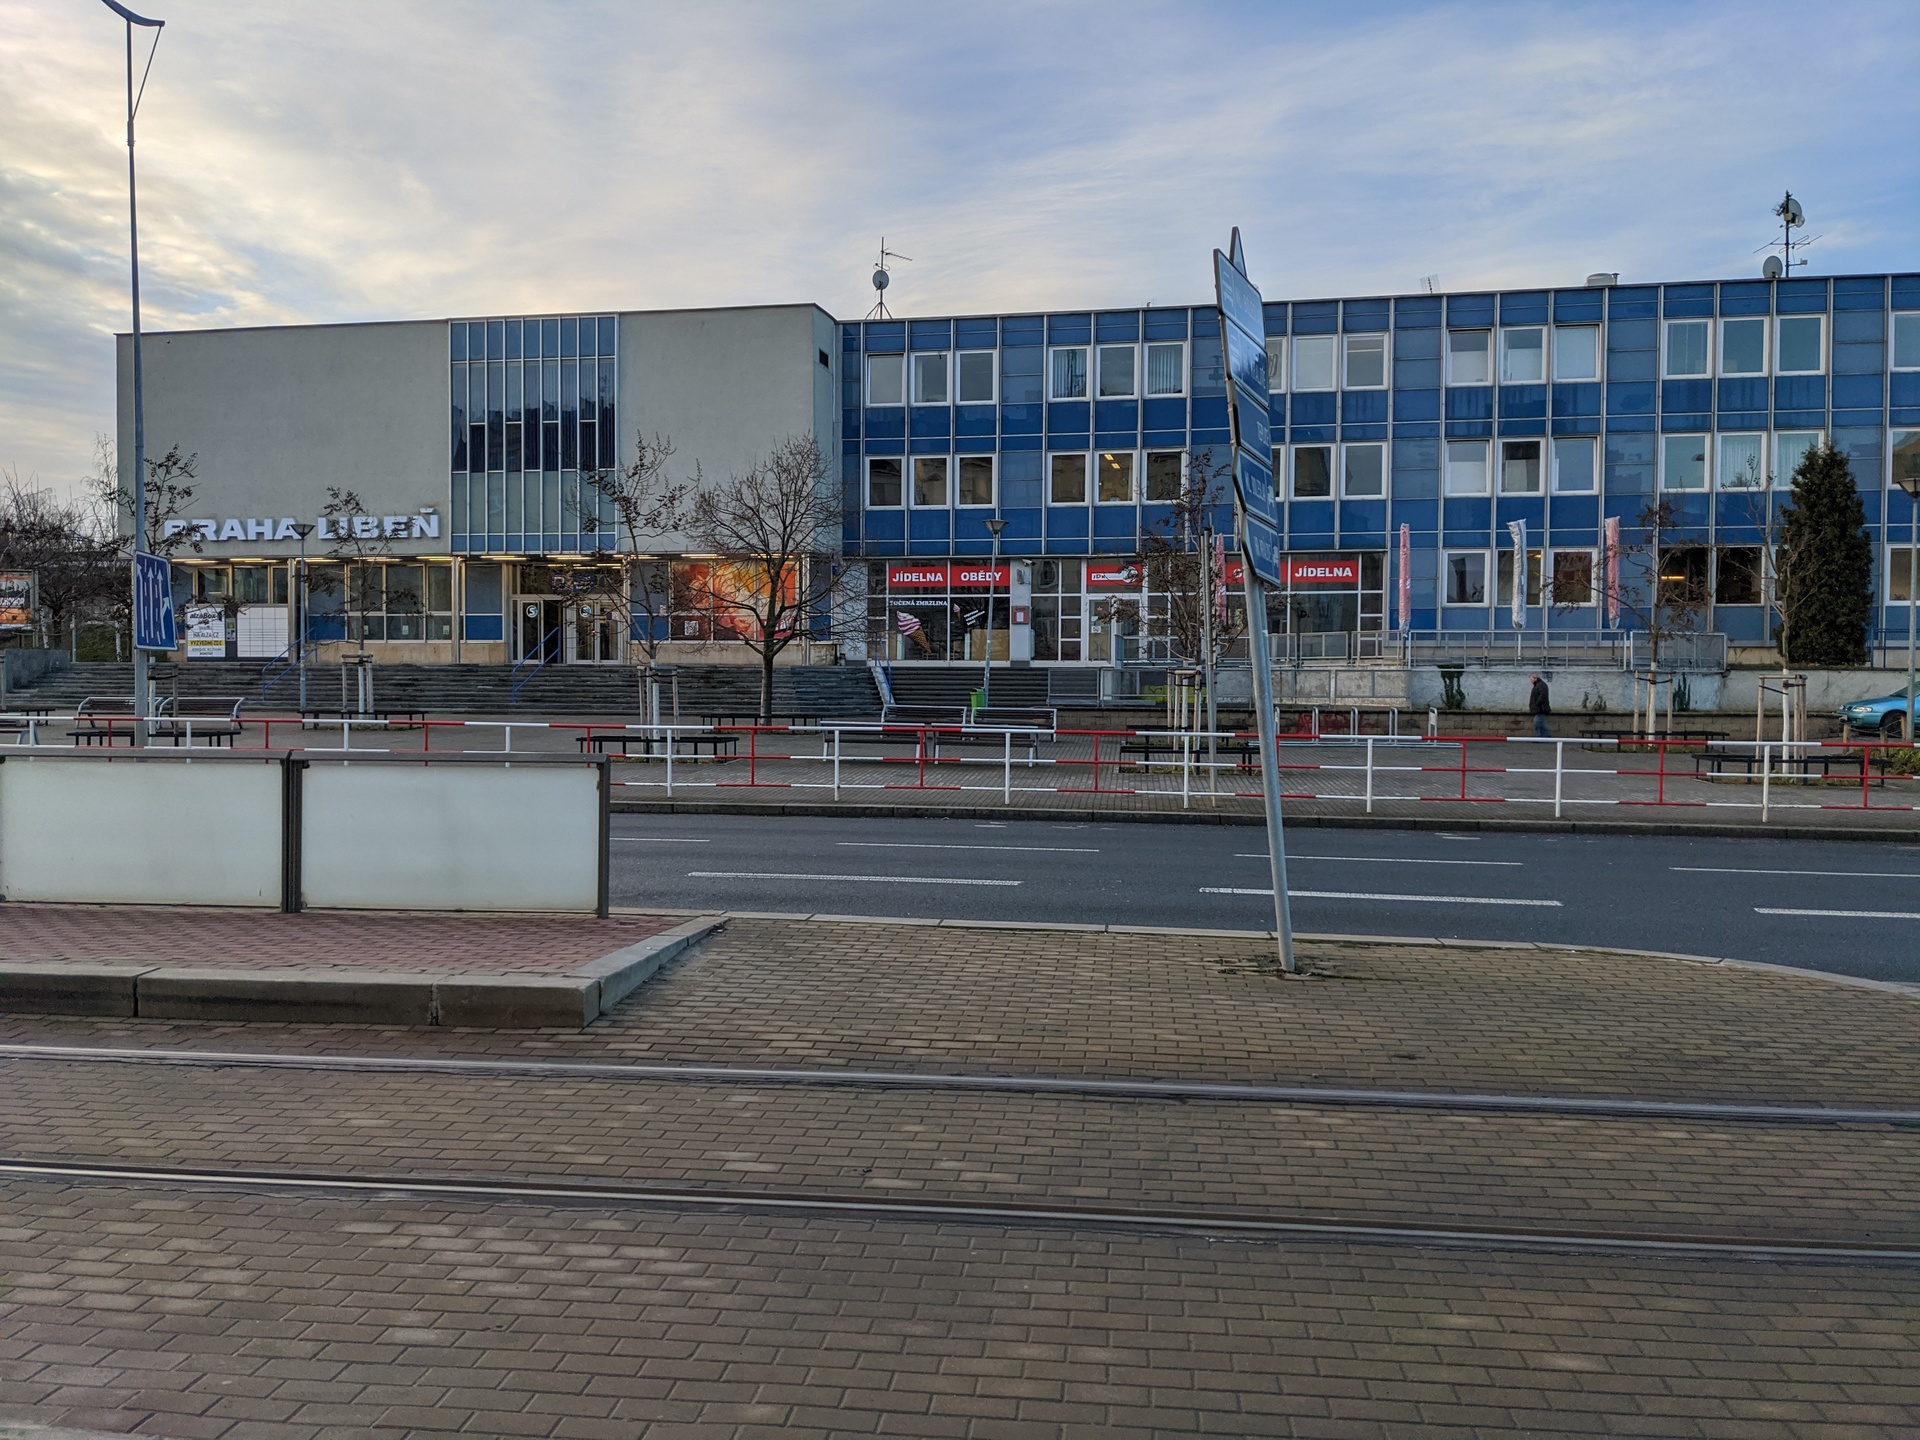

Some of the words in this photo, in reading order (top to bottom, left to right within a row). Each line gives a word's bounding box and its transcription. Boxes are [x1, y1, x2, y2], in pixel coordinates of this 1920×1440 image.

[164, 518, 302, 541] PRAHA
[317, 507, 440, 540] LIBEŇ
[892, 570, 943, 582] JÍDELNA
[961, 570, 1002, 582] OBĚDY
[1295, 566, 1353, 577] JÍDELNA
